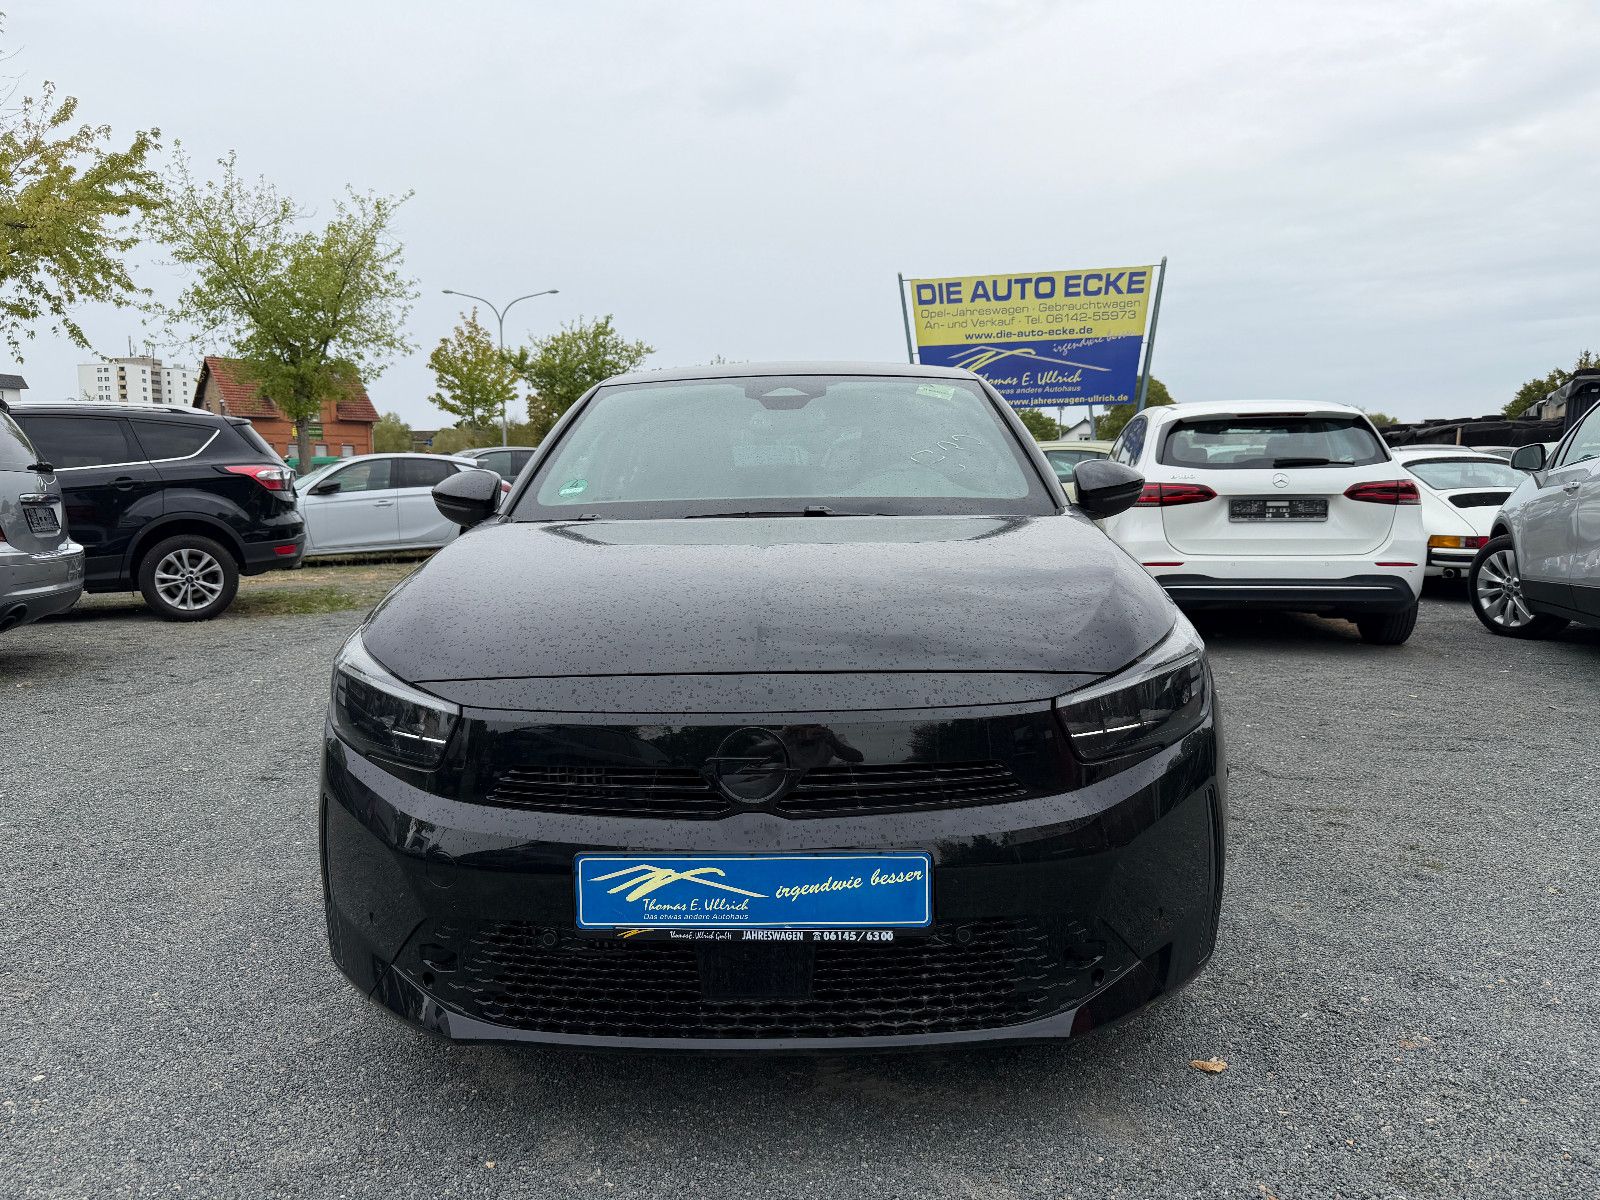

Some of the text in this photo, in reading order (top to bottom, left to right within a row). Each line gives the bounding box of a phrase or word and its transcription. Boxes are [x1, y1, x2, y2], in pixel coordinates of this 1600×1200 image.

[916, 271, 1147, 305] DIE AUTO ECKE
[921, 300, 1140, 319] Opel-Jahreswagen Gebrauchtwagen
[924, 310, 1136, 330] An- und Verkauf Tel. 06142-55973
[965, 326, 1093, 340] www.die-auto-ecke.de
[1021, 371, 1033, 386] E.
[1037, 368, 1082, 386] Ullrich
[1043, 385, 1081, 393] Autohaus
[1008, 395, 1128, 406] www.jahreswagen-ullrich.de
[775, 868, 924, 902] irgendwie besser
[643, 898, 749, 911] Thomas E. Ullrich
[742, 931, 803, 941] JAHRESWAGEN
